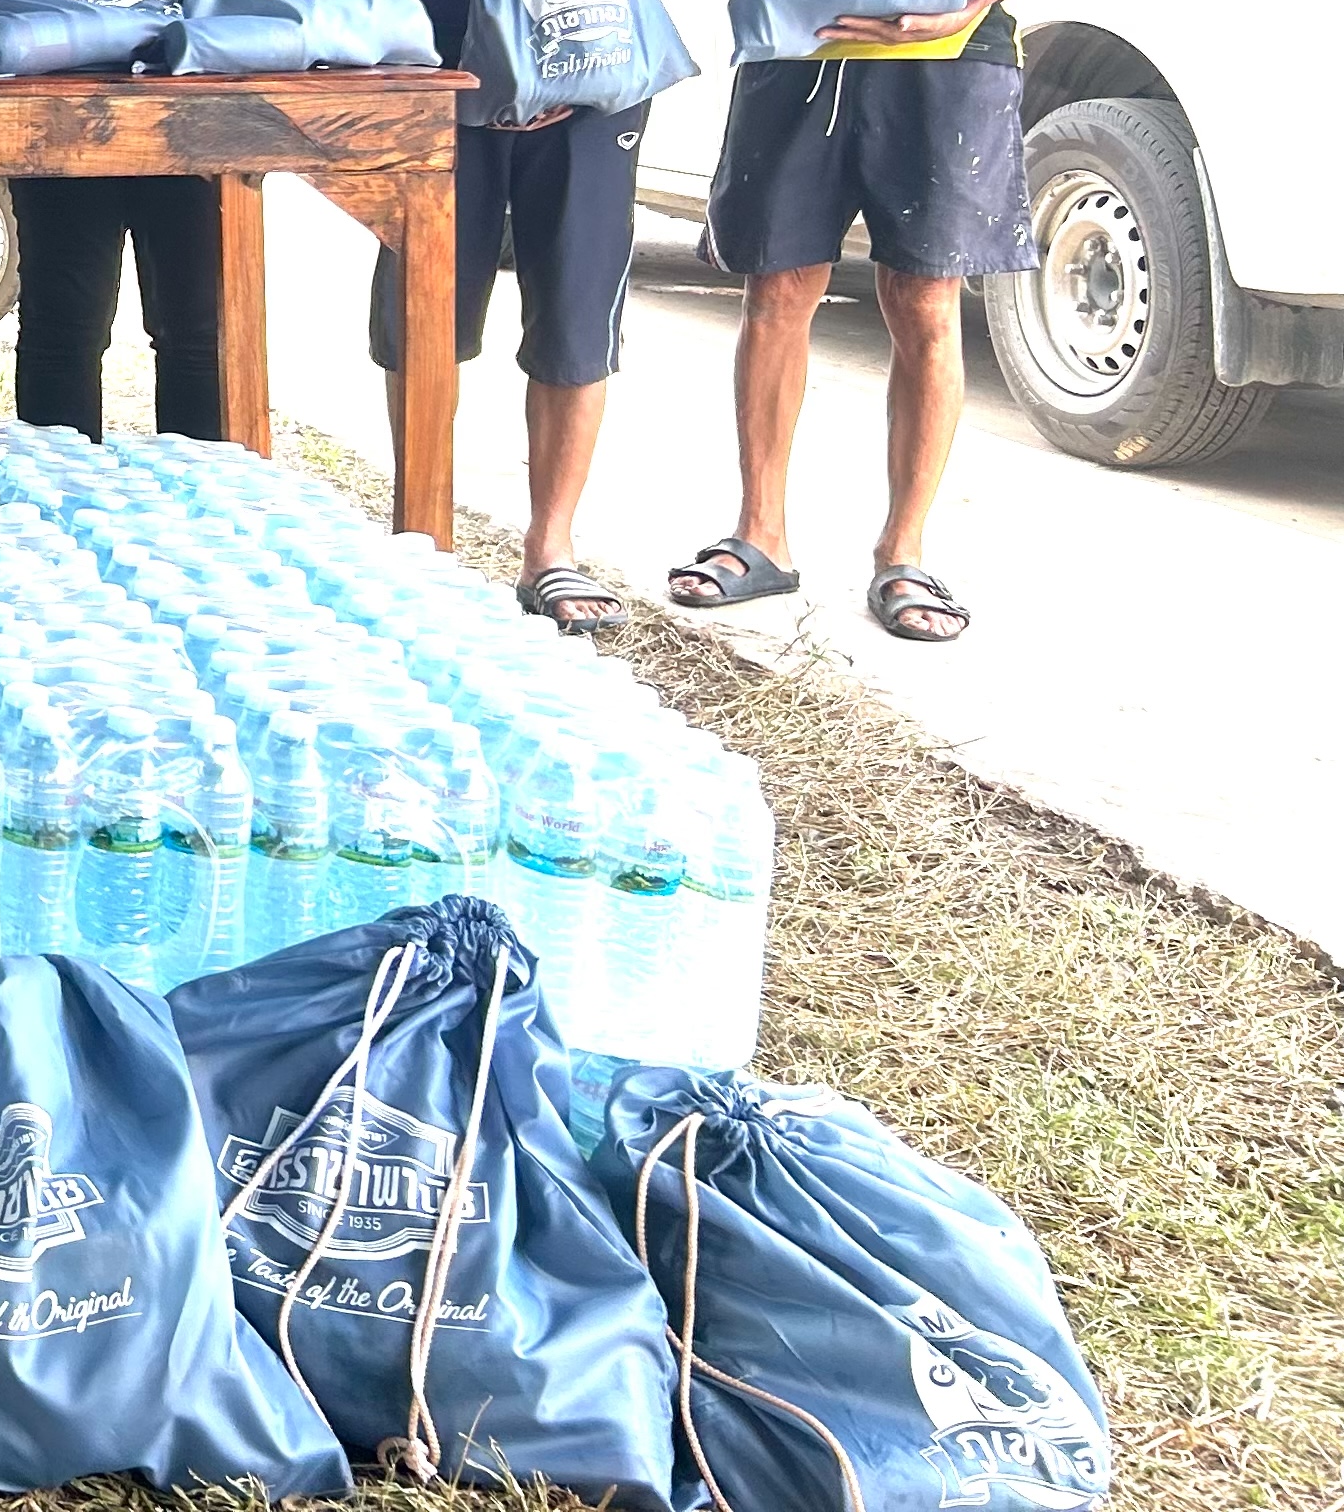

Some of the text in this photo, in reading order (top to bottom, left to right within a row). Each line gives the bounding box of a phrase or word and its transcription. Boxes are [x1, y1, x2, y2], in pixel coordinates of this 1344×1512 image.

[349, 1214, 382, 1231] 1935
[30, 1277, 135, 1333] Original
[305, 1276, 336, 1310] of
[336, 1276, 372, 1307] the
